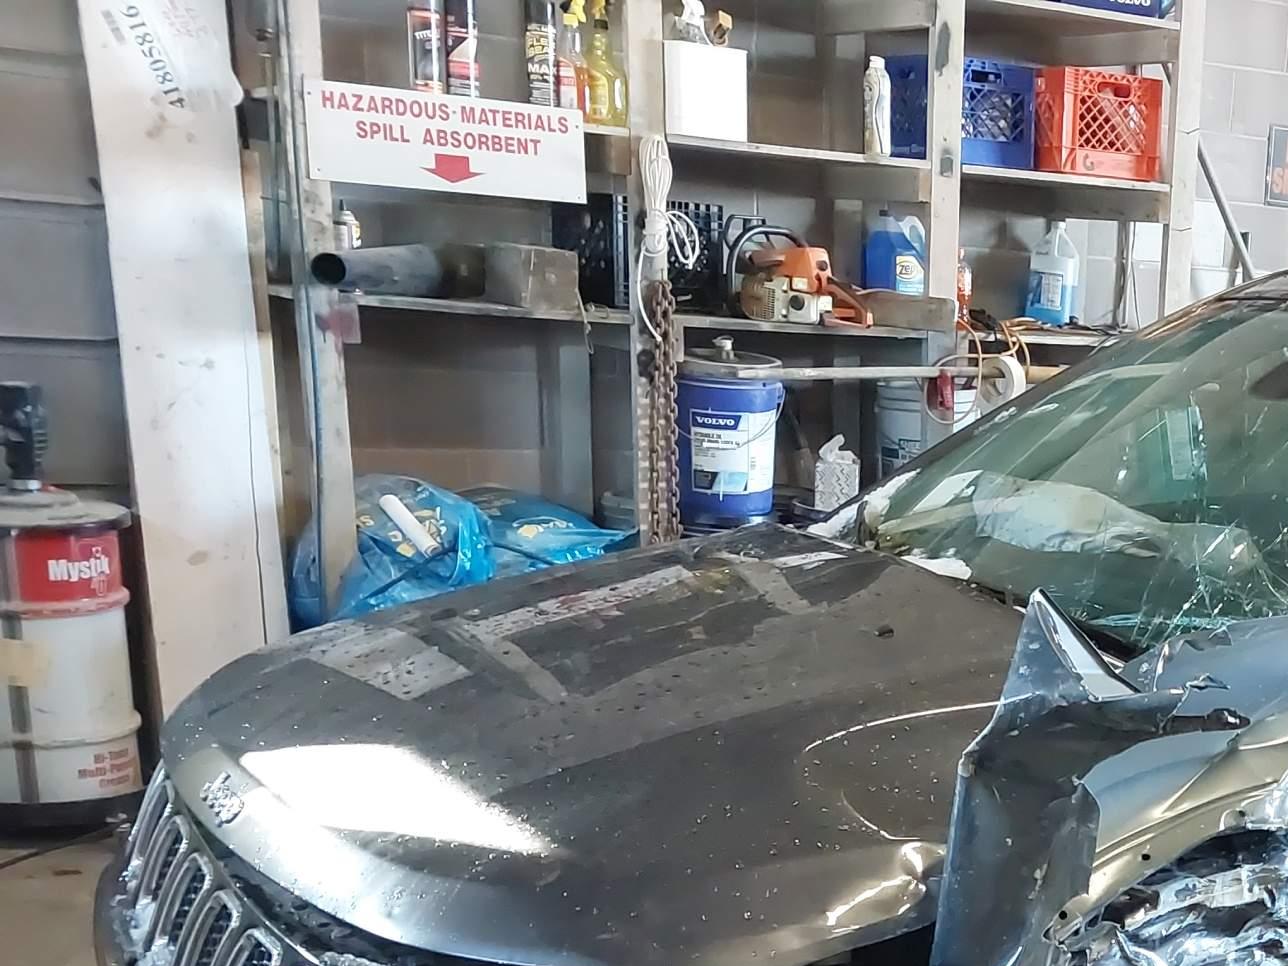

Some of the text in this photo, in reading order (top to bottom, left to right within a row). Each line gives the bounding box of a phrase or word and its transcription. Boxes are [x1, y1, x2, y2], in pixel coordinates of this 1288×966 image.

[321, 89, 569, 134] HAZARDOUS MATERIALS
[356, 121, 542, 156] SPILL ABSORBENT
[695, 416, 736, 426] VOLVO
[48, 555, 110, 582] Mystik
